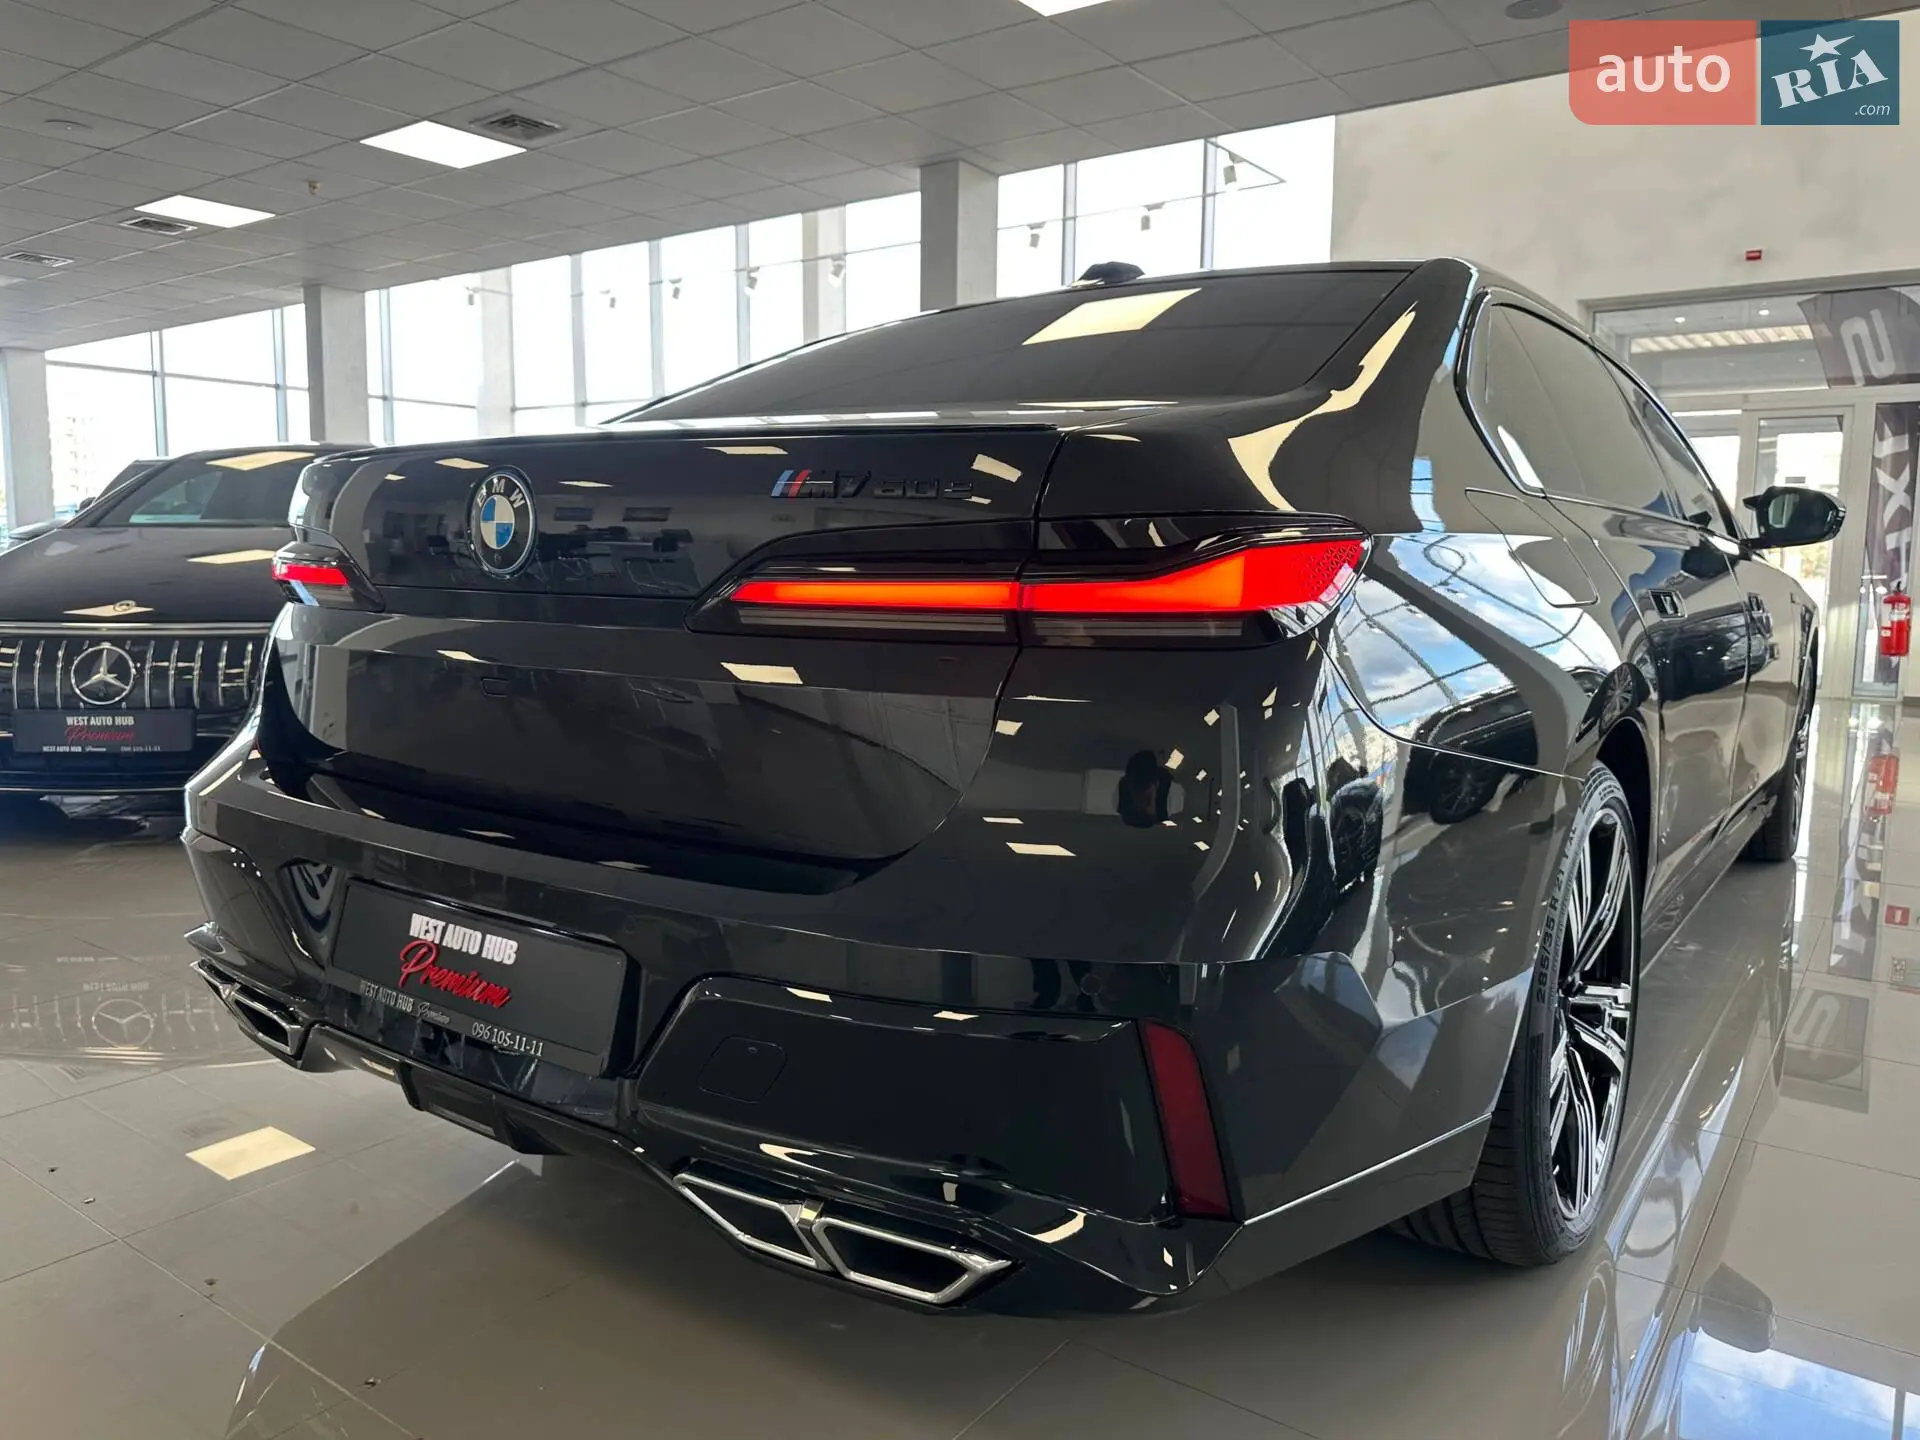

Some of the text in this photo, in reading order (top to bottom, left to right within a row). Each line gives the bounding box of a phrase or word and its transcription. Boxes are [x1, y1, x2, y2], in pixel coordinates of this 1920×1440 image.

[477, 475, 526, 509] BMW
[66, 716, 135, 726] WEST AUTO HUB
[409, 912, 519, 965] WEST AUTO HUB
[1536, 914, 1555, 1004] 285/35
[397, 939, 512, 1009] Premium
[359, 979, 377, 998] WEST
[376, 987, 397, 1007] AUTO
[396, 992, 414, 1013] HUB
